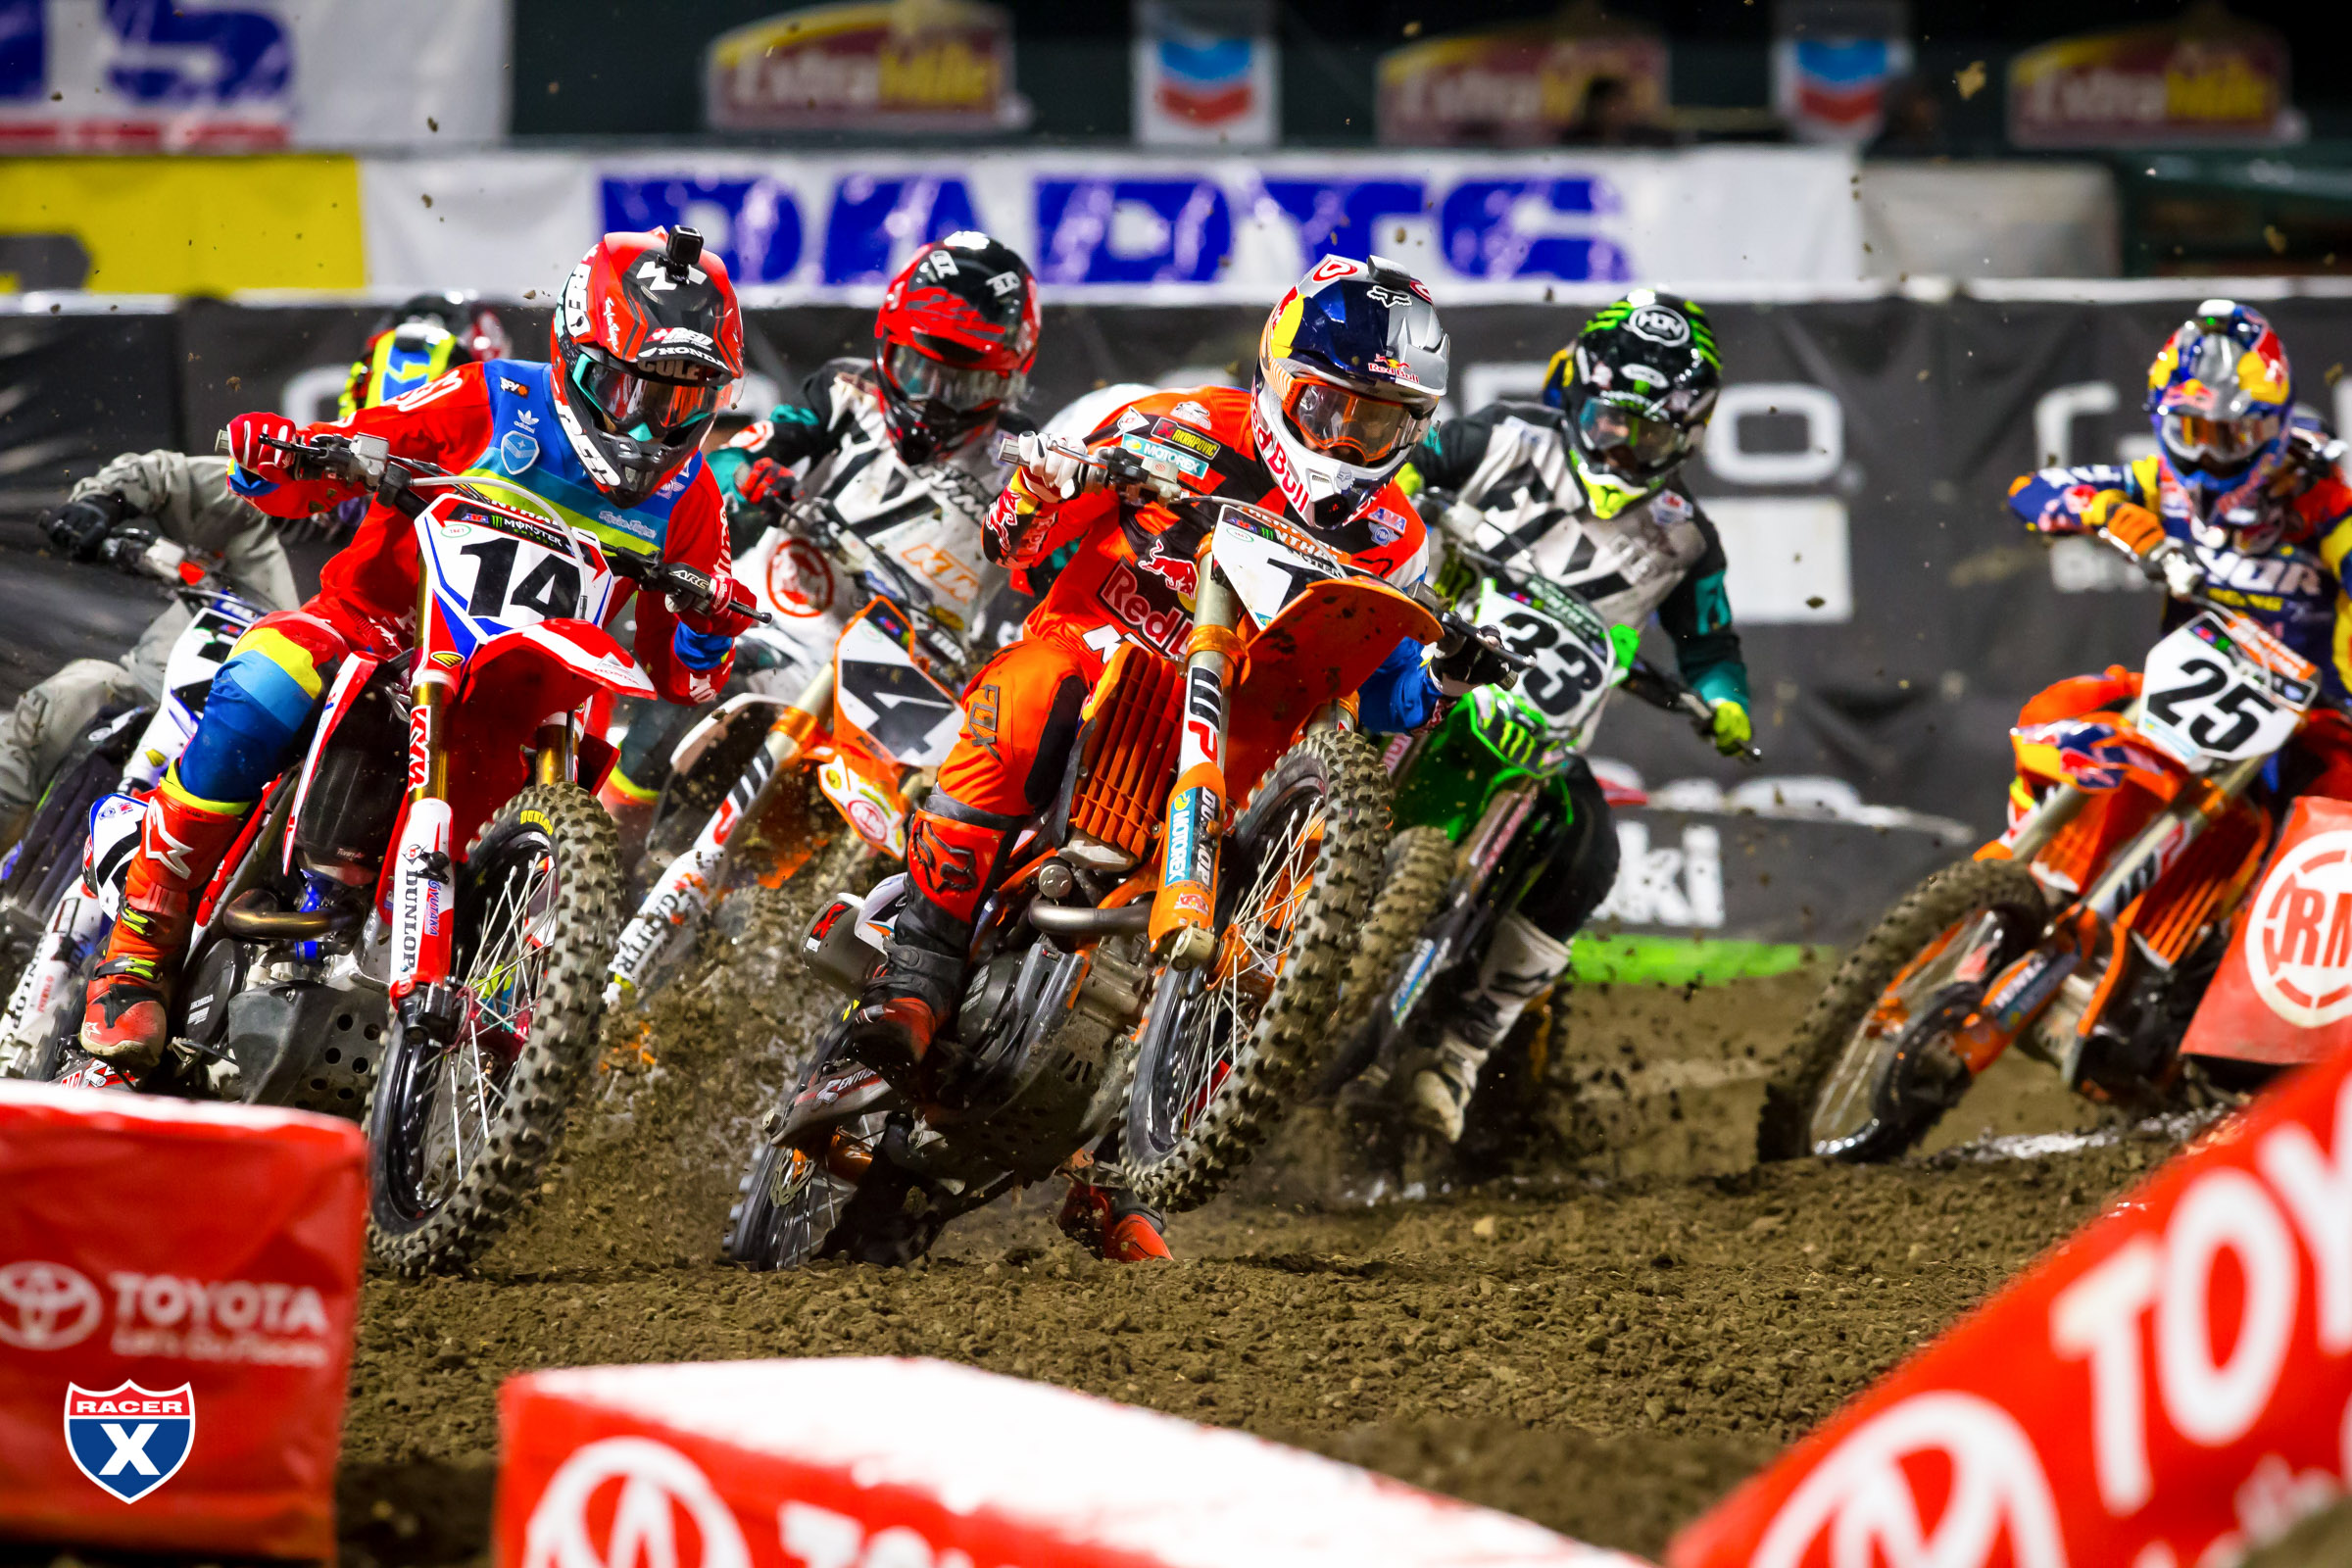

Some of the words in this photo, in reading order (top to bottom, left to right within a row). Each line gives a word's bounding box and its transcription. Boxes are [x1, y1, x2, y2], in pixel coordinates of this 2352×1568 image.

[658, 347, 730, 371] HONDA
[1367, 363, 1395, 376] Red
[1396, 368, 1420, 384] Bull
[1143, 443, 1200, 474] MOTOREX
[1267, 441, 1310, 513] Bull
[1373, 506, 1407, 533] AMA
[460, 537, 581, 620] 14
[670, 569, 710, 590] ARC
[1100, 561, 1185, 650] Red
[1499, 612, 1604, 717] 33
[967, 685, 1003, 762] FOX
[2146, 659, 2279, 753] 25
[519, 809, 554, 836] DUNLOP
[1167, 809, 1191, 882] MOTOREX
[403, 869, 419, 968] DUNLOP
[108, 1271, 329, 1332] TOYOTA
